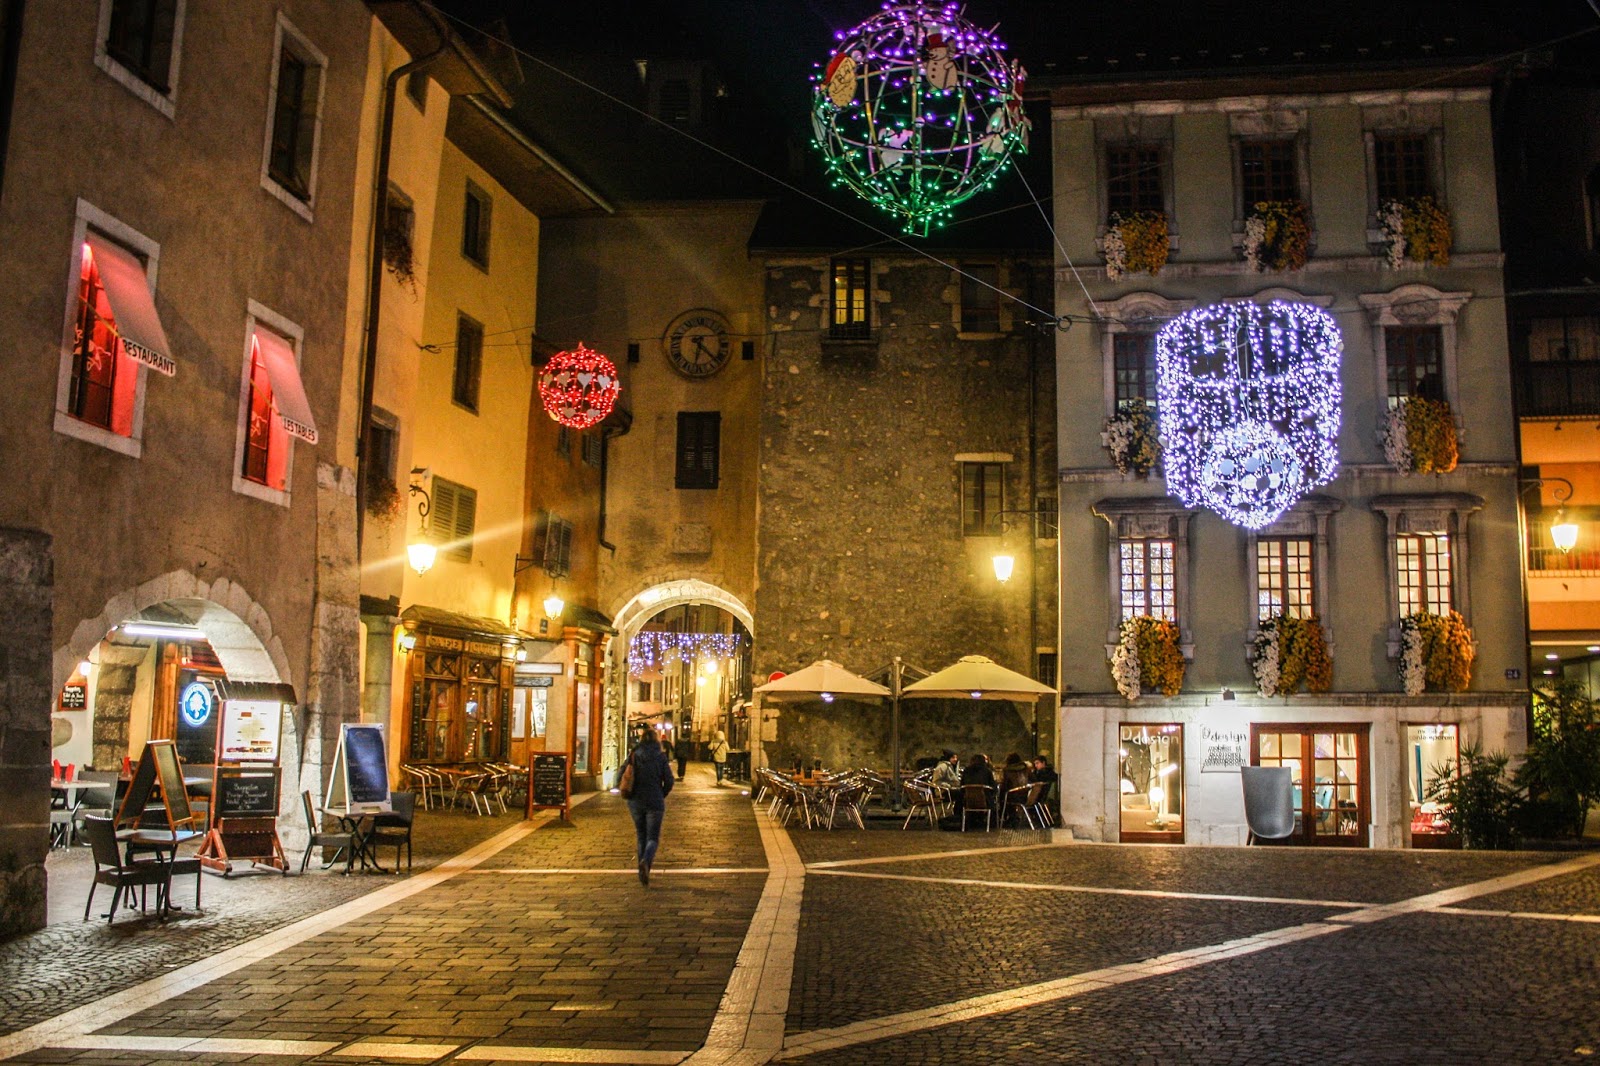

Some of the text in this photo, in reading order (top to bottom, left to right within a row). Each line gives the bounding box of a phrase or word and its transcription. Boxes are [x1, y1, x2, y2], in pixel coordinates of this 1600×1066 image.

[122, 339, 175, 375] RESTAURANT
[283, 417, 316, 442] LES TABLES
